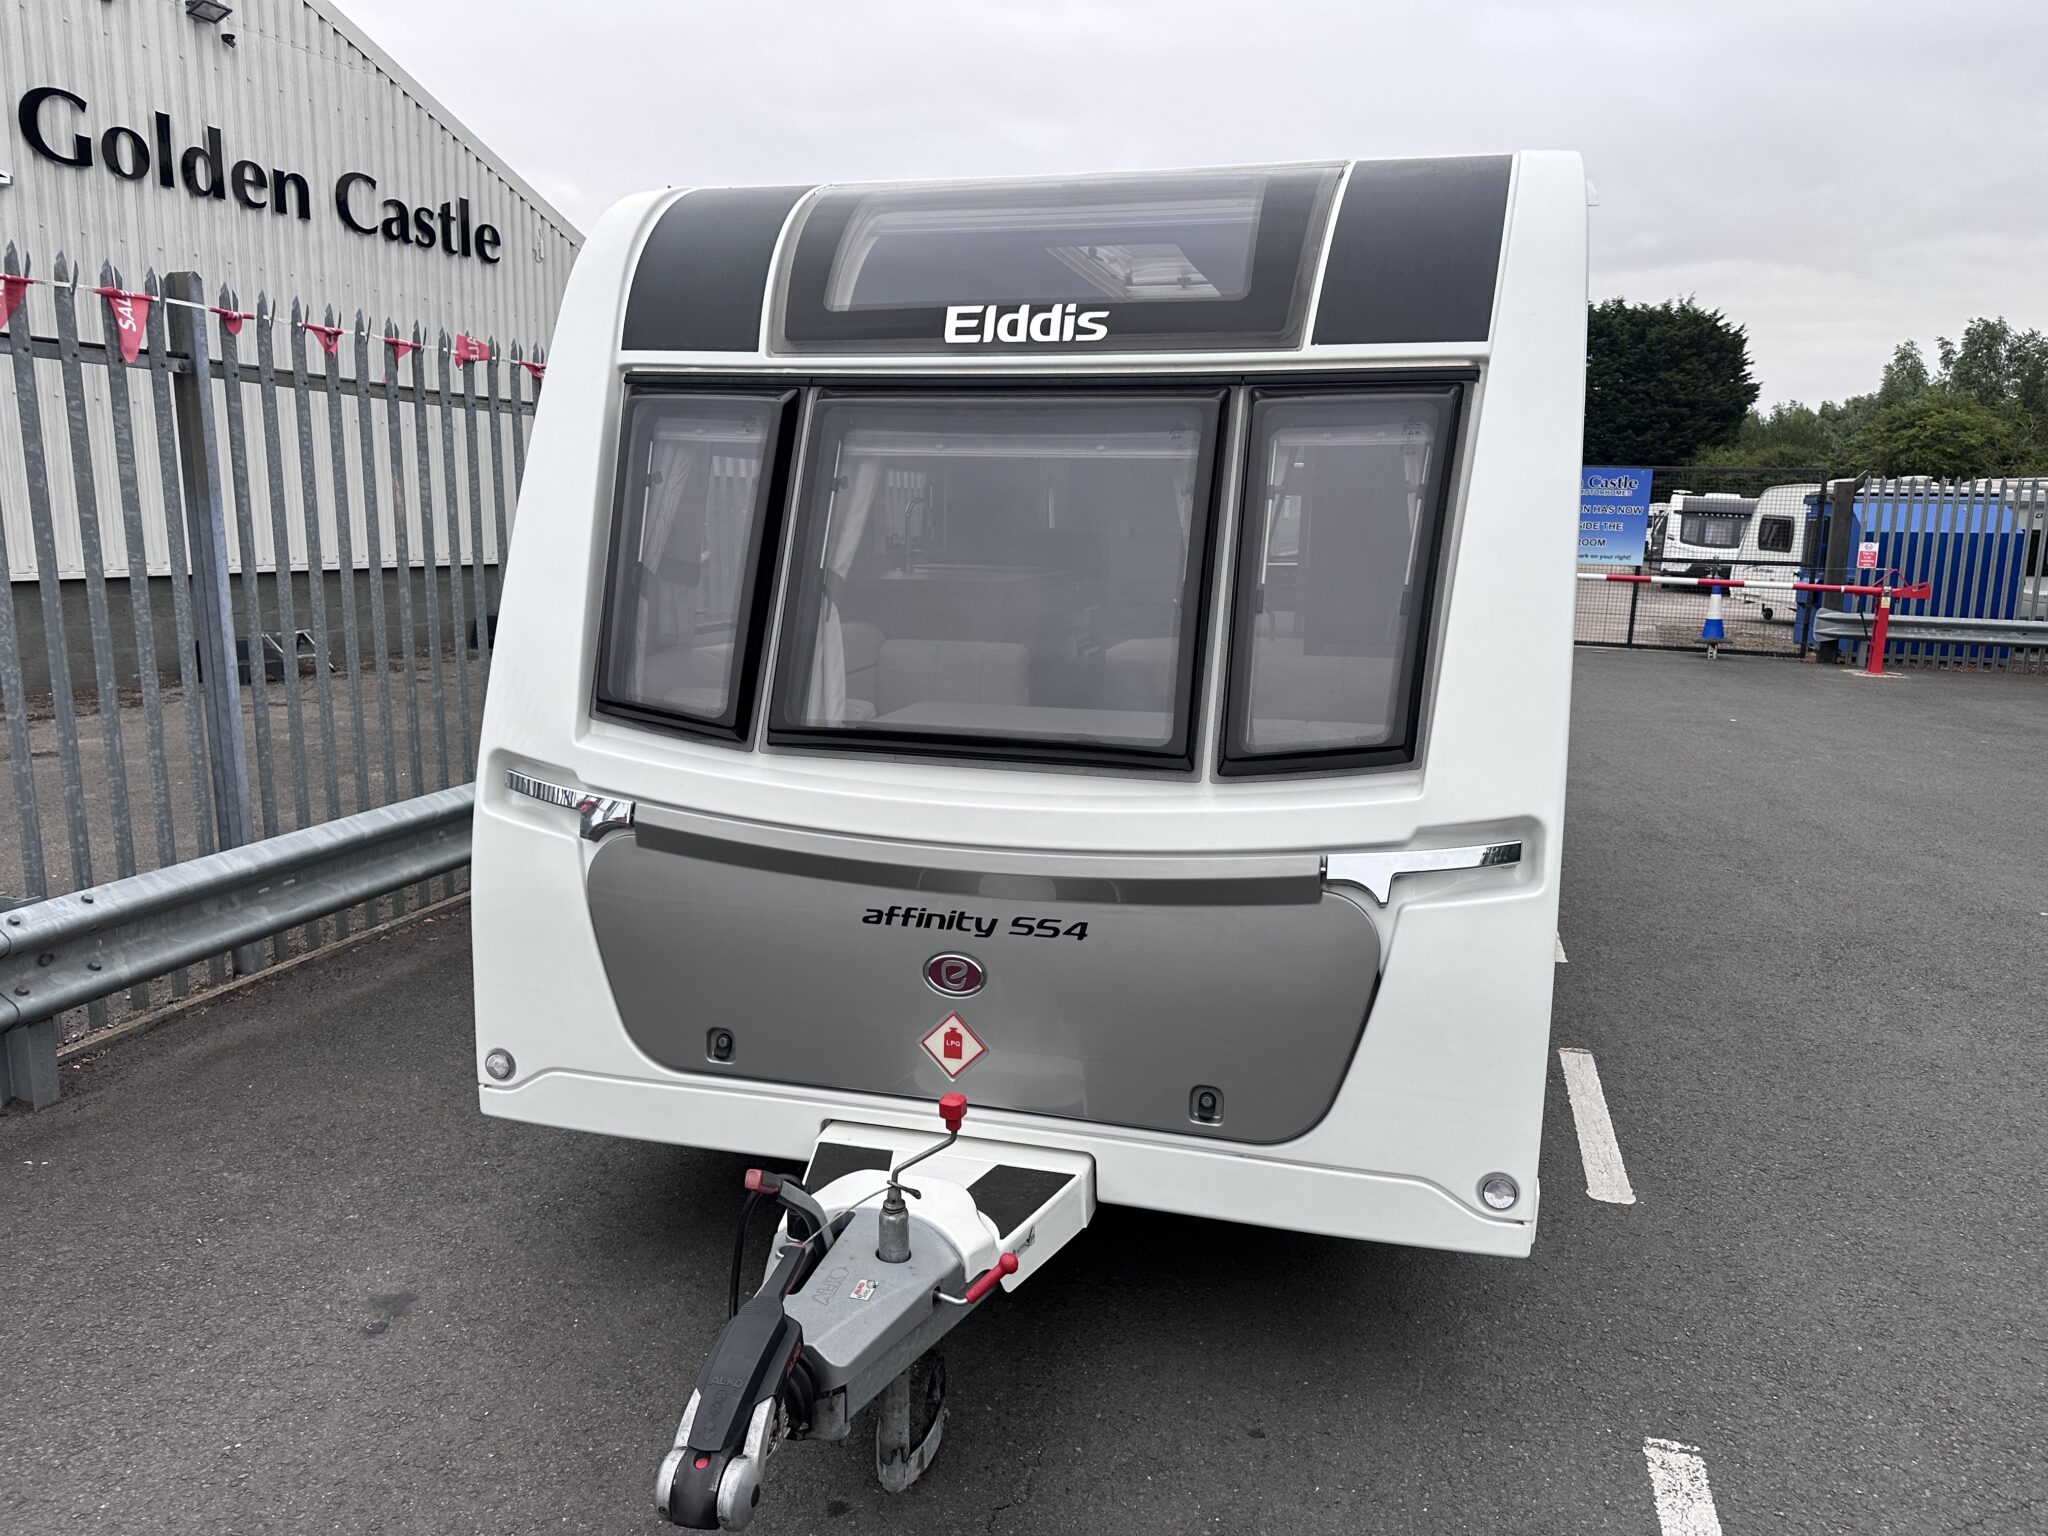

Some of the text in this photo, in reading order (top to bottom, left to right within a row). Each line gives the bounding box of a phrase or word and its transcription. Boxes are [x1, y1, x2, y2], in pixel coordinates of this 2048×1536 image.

[18, 86, 502, 264] Golden Castle
[944, 303, 1110, 343] Elddis
[1588, 475, 1639, 489] Castle
[1593, 505, 1615, 513] HAS
[1617, 506, 1644, 514] NOW
[1602, 522, 1623, 531] THE
[862, 905, 998, 938] affinity
